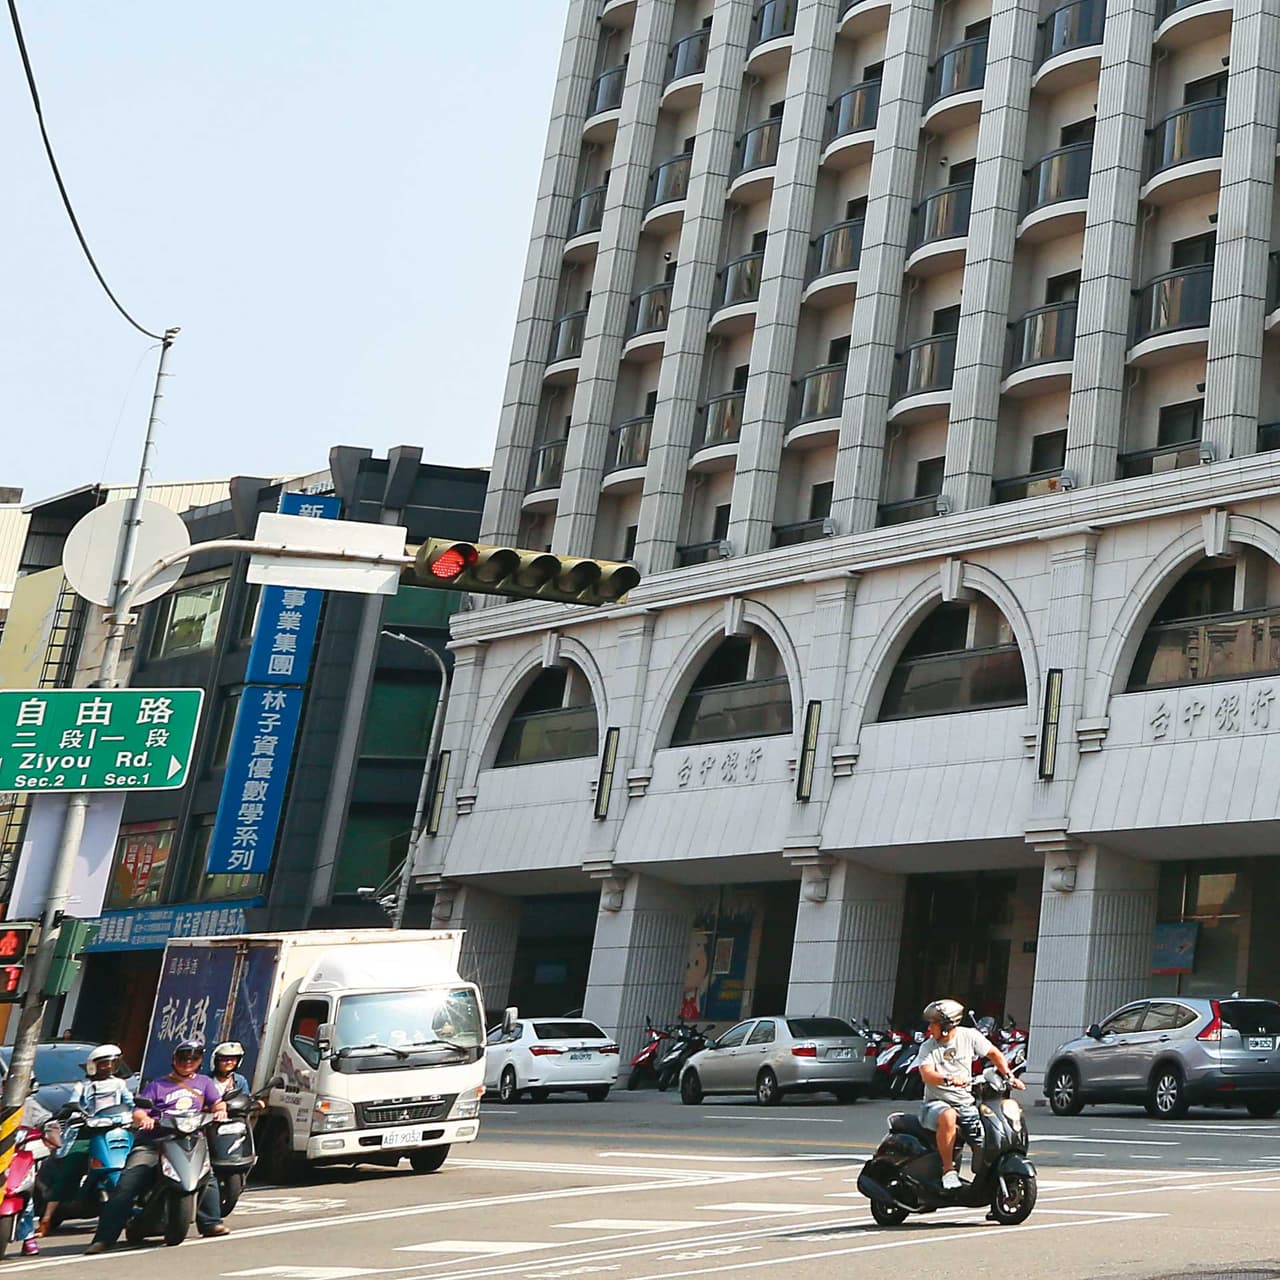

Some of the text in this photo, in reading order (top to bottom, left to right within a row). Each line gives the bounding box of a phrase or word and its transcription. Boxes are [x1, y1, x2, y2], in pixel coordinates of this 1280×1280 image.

[15, 696, 174, 726] 自由路
[1149, 687, 1277, 741] 台中銀行
[14, 772, 150, 787] Sec.2 Sec.1
[19, 751, 153, 773] Ziyou Rd.
[226, 689, 288, 871] 林子資優數學系列
[677, 746, 764, 788] 台中銀行
